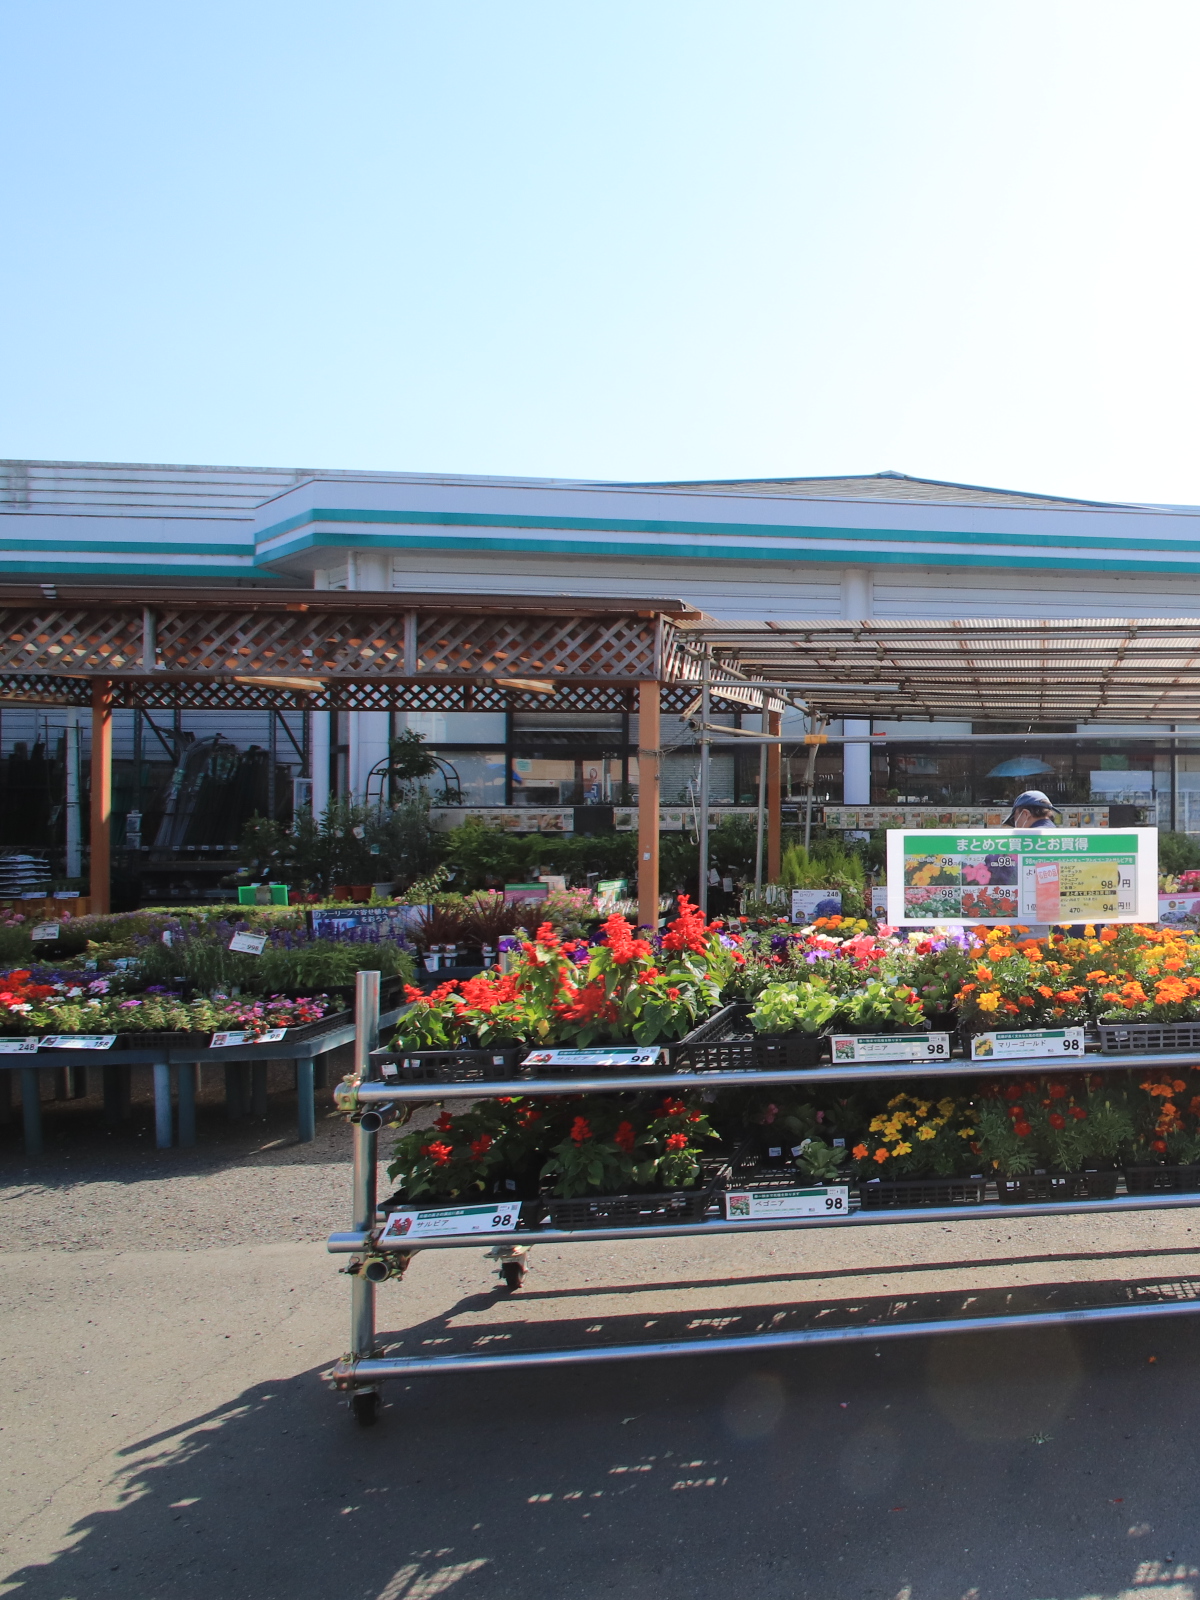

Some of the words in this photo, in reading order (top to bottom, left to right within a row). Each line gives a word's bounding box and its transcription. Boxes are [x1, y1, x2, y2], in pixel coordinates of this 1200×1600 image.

[956, 838, 1089, 852] まとめて買うとお買得
[941, 857, 954, 867] 98
[1100, 880, 1113, 889] 98
[1122, 879, 1131, 888] 円
[826, 890, 839, 898] 248
[941, 889, 954, 898] 98
[998, 889, 1011, 898] 98
[1102, 903, 1114, 912] 94
[18, 1043, 35, 1051] 248
[927, 1044, 945, 1055] 98
[998, 1040, 1047, 1048] マリーゴールド
[1063, 1039, 1080, 1051] 98
[630, 1055, 650, 1063] 98
[825, 1197, 843, 1210] 98
[417, 1219, 449, 1227] サルビア
[491, 1214, 512, 1228] 98
